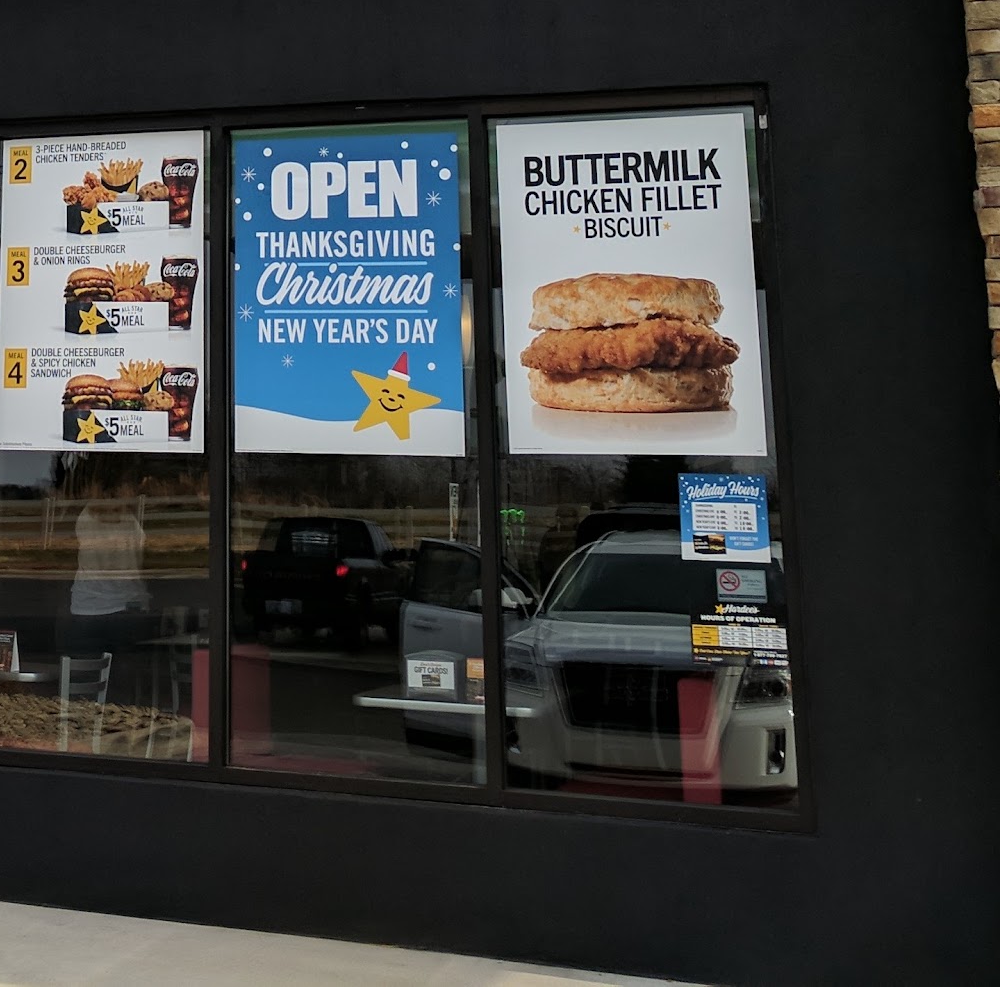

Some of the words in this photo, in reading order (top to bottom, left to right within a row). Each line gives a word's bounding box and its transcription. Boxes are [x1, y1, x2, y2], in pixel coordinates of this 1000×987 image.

[35, 143, 64, 154] 3-PIECE
[66, 140, 126, 152] HAND-BREADED
[35, 153, 68, 164] CHICKEN
[523, 147, 721, 187] BUTTERMILK
[14, 159, 27, 180] 2
[163, 163, 197, 177] Coca-Cola
[270, 159, 418, 220] OPEN
[524, 188, 633, 216] CHICKEN
[641, 183, 722, 212] FILLET
[107, 208, 121, 226] $5
[122, 215, 145, 226] MEAL
[584, 216, 663, 239] BISCUIT
[33, 246, 64, 255] DOUBLE
[65, 244, 126, 255] CHEESEBURGER
[255, 228, 435, 259] THANKSGIVING
[33, 257, 39, 265] &
[40, 256, 66, 265] ONION
[67, 255, 91, 264] RINGS
[12, 260, 25, 282] 3
[163, 262, 198, 277] Coca-Cola
[255, 261, 434, 306] Christmas
[106, 308, 121, 327] $5
[131, 305, 144, 313] STAR
[121, 315, 144, 327] MEAL
[258, 318, 306, 343] NEW
[313, 318, 388, 343] YEAR'S
[395, 318, 438, 344] DAY
[31, 348, 62, 357] DOUBLE
[63, 347, 125, 357] CHEESEBURGER
[31, 358, 37, 367] &
[38, 358, 61, 367] SPICY
[62, 358, 96, 367] CHICKEN
[7, 362, 23, 384] 4
[31, 368, 72, 378] SANDWICH
[162, 371, 197, 387] Coca-Cola
[104, 417, 119, 436] $5
[130, 414, 143, 422] STAR
[120, 424, 144, 436] MEAL
[686, 482, 727, 500] Holiday
[727, 481, 760, 497] Hours
